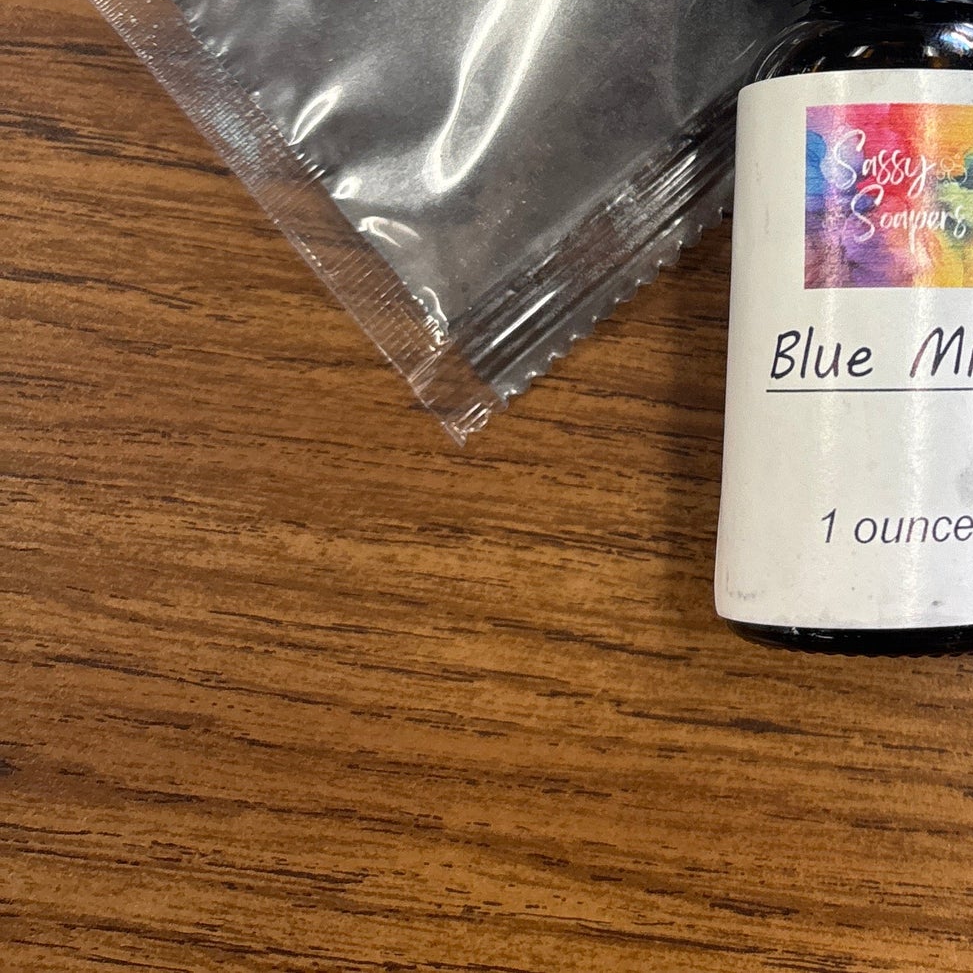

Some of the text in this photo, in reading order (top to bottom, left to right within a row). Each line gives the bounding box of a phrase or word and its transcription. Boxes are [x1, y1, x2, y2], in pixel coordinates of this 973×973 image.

[833, 128, 935, 198] Sassy
[770, 326, 874, 379] Blue
[820, 508, 837, 544] 1
